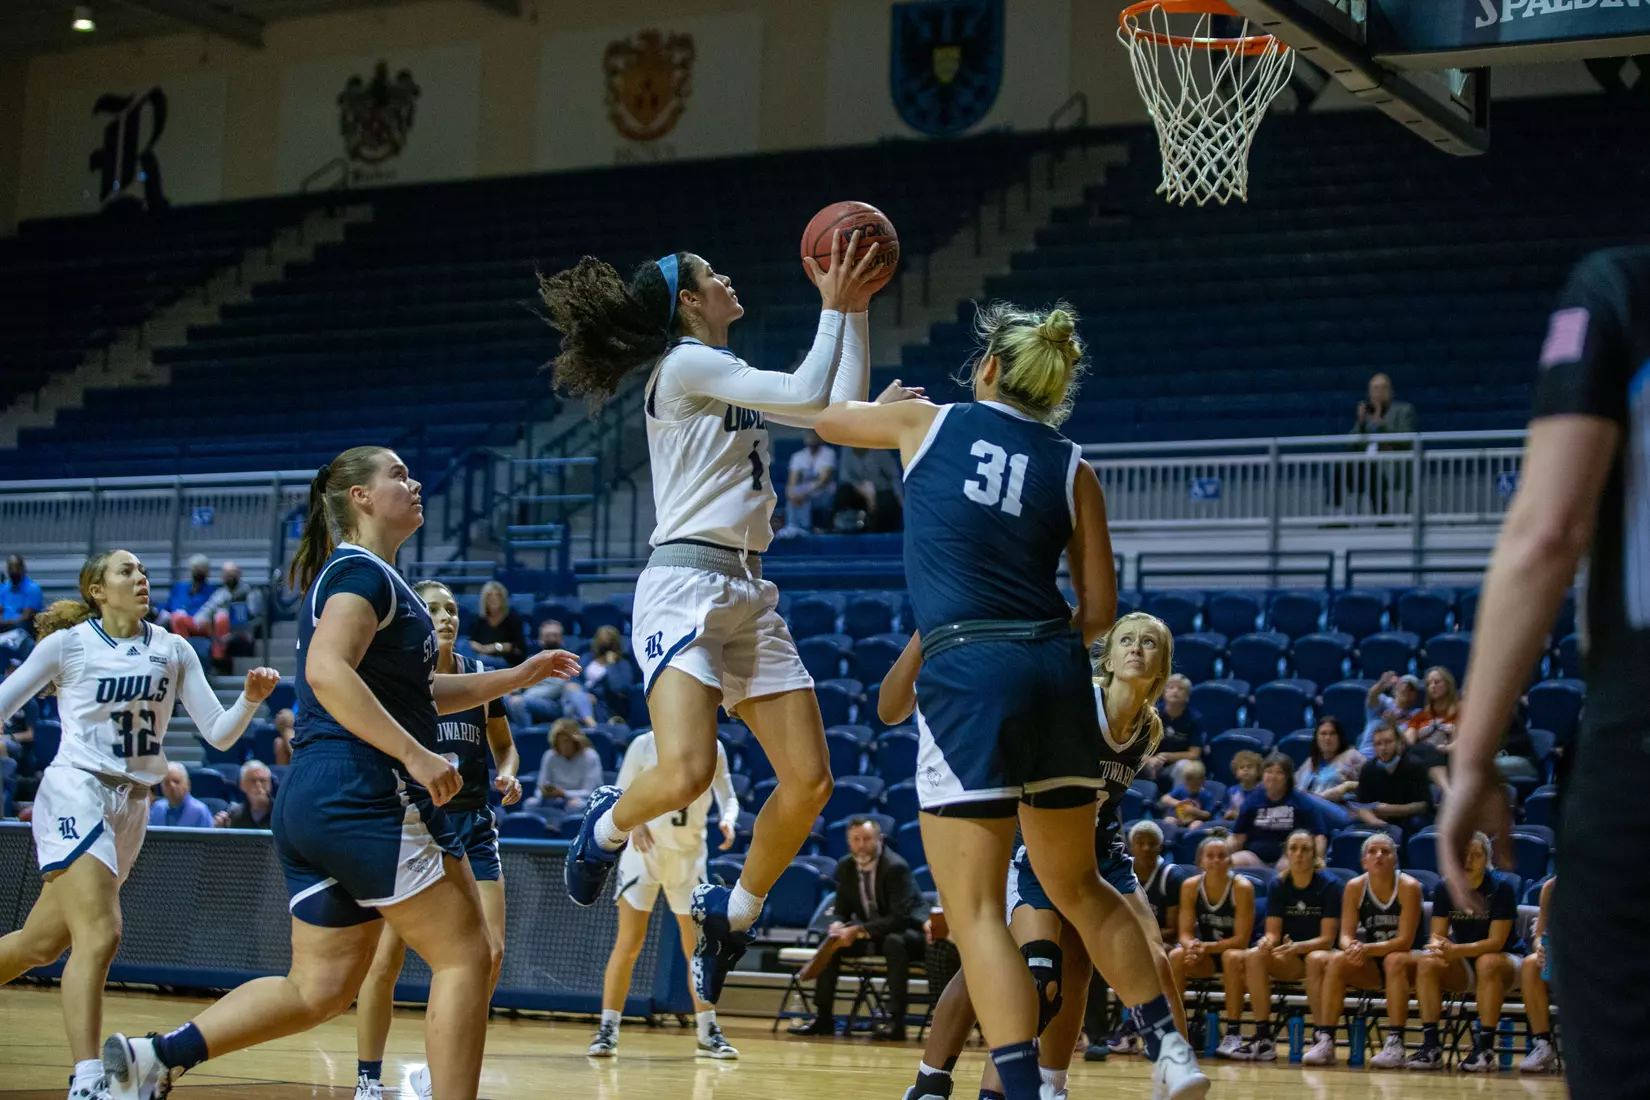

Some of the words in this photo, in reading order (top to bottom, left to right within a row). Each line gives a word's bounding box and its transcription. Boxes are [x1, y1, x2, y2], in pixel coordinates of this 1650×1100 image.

[724, 404, 767, 432] OWL
[748, 439, 764, 491] 1
[963, 439, 1029, 517] 31
[645, 630, 664, 661] R
[96, 675, 169, 704] OWLS
[110, 709, 161, 758] 32
[437, 721, 480, 745] DWARD'S
[58, 816, 80, 840] R
